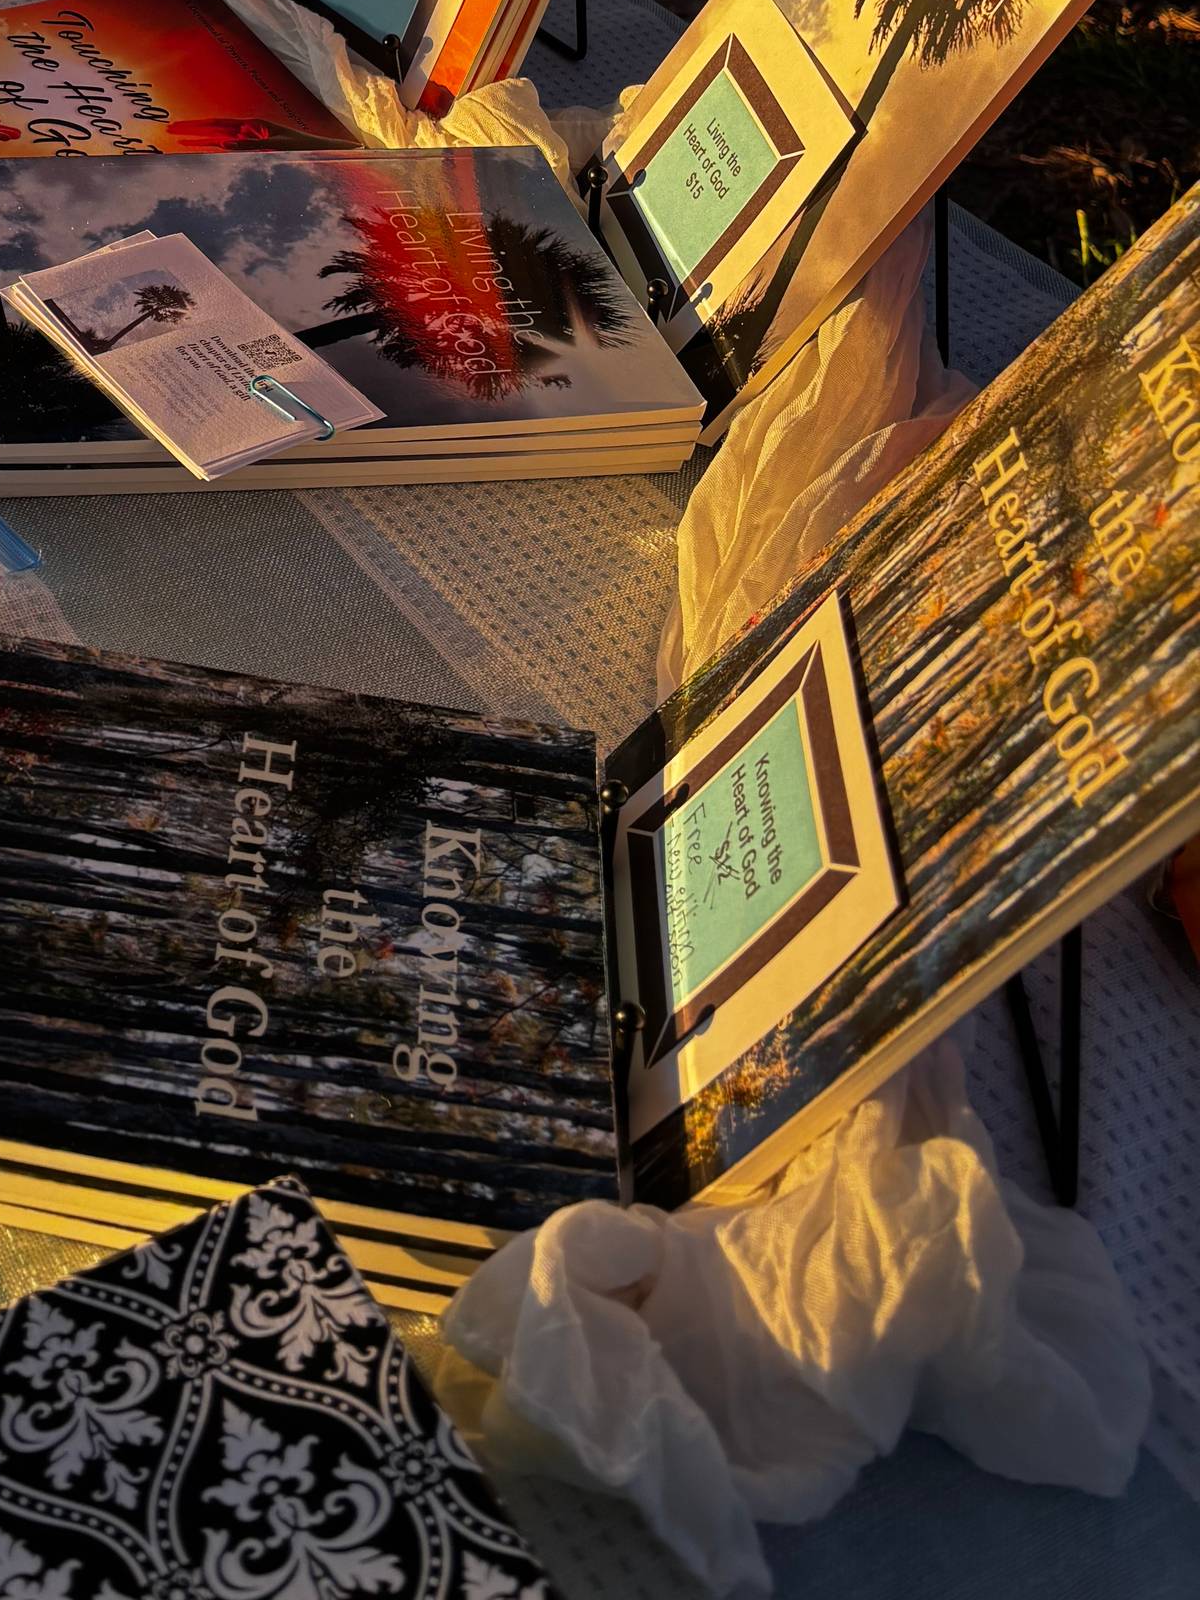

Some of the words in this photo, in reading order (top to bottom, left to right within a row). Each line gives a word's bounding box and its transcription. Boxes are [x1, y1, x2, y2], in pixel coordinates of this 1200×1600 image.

[7, 29, 60, 72] the
[46, 78, 164, 157] Heart
[41, 8, 171, 125] Touching
[28, 118, 88, 158] Go
[683, 122, 709, 159] Heart
[701, 150, 717, 173] of
[709, 166, 732, 200] God
[705, 116, 732, 158] Living
[724, 145, 743, 177] the
[684, 170, 704, 200] $15
[376, 189, 448, 273] Heart
[421, 275, 473, 308] of
[446, 211, 514, 297] Living
[509, 298, 546, 346] the
[175, 345, 189, 358] for
[183, 355, 201, 371] you.
[187, 343, 209, 362] Heart
[206, 360, 220, 371] of
[214, 368, 233, 386] God,
[235, 389, 252, 402] gift
[200, 339, 227, 363] chapter
[223, 361, 238, 373] of
[231, 371, 252, 392] Livin
[211, 335, 248, 369] Download
[243, 363, 257, 378] the
[442, 312, 511, 375] God
[972, 427, 1051, 594] Heart
[1088, 488, 1148, 590] the
[1020, 590, 1084, 666] of
[1040, 655, 1131, 811] God
[224, 731, 297, 898] Heart
[731, 763, 751, 824] Heart
[755, 751, 777, 849] Knowing
[767, 844, 783, 886] the
[682, 801, 707, 868] Free
[740, 828, 752, 850] of
[740, 849, 761, 900] God
[214, 910, 273, 992] of
[316, 887, 378, 980] the
[390, 820, 483, 1094] Knowing
[670, 929, 684, 988] soon
[190, 987, 271, 1124] God
